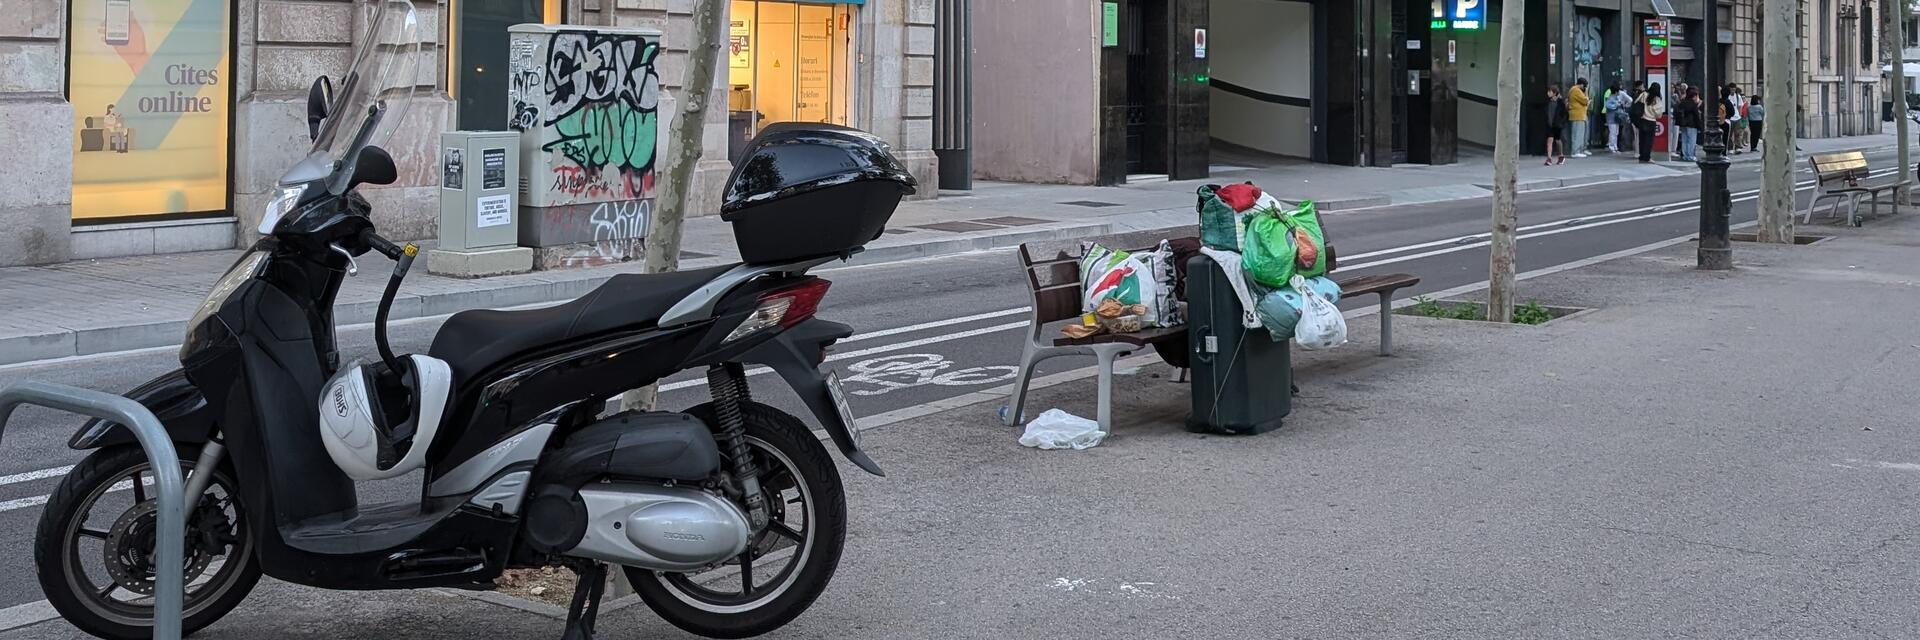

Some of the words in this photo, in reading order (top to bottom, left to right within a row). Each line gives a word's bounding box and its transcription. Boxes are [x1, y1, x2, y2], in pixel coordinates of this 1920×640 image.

[1456, 0, 1478, 18] P
[164, 63, 218, 86] Cites
[138, 91, 212, 113] online
[335, 386, 349, 414] SHOEI
[663, 531, 705, 541] HONDA
